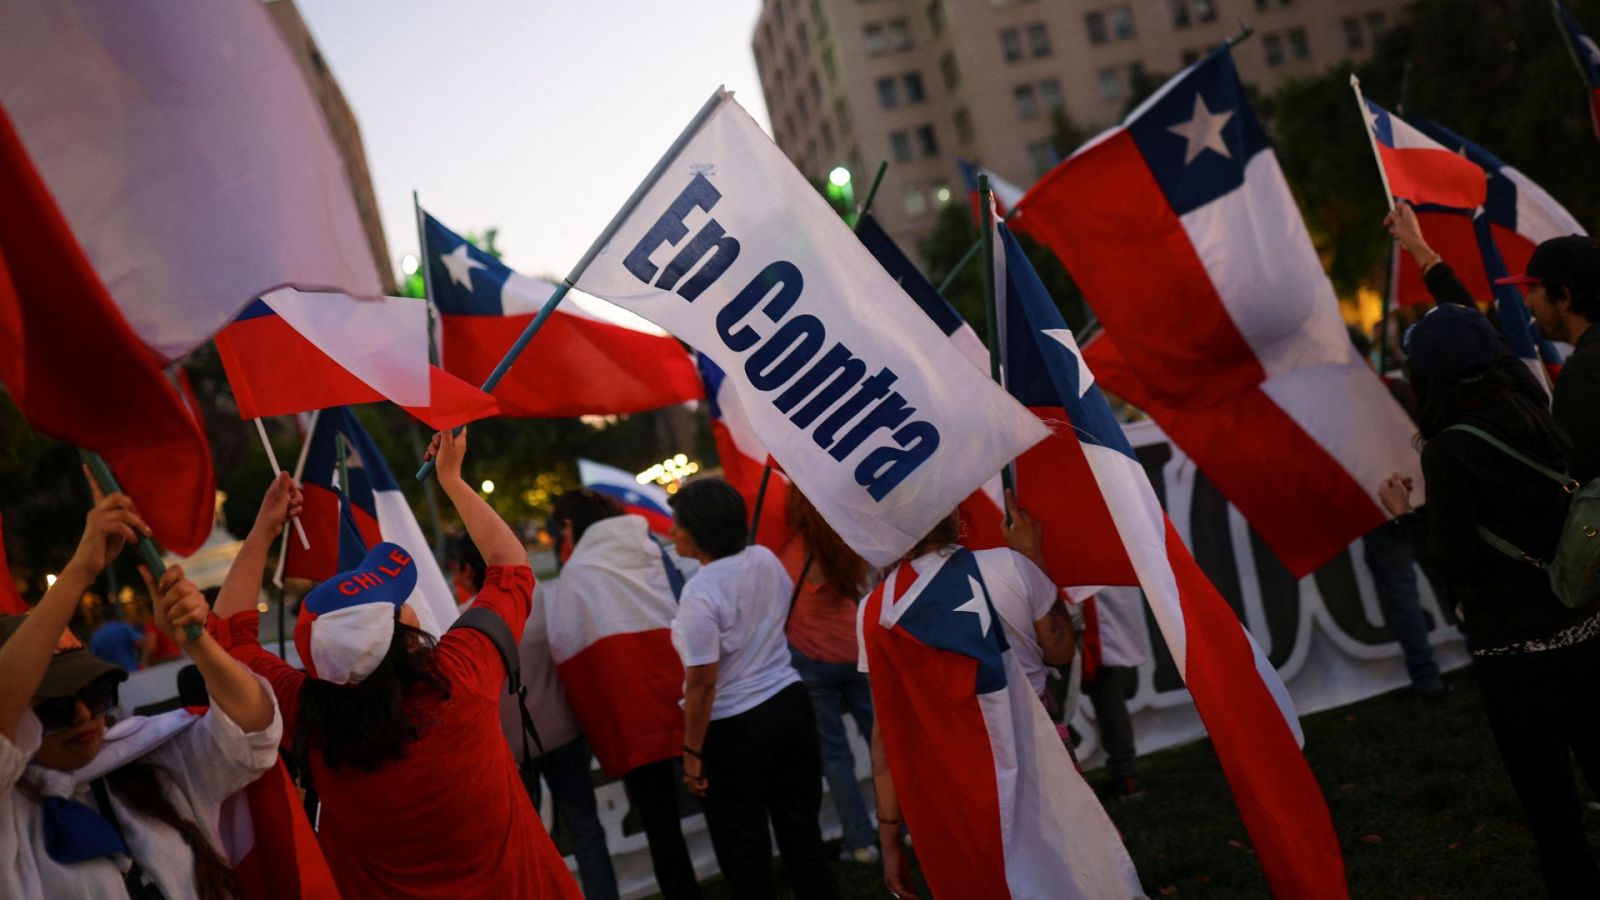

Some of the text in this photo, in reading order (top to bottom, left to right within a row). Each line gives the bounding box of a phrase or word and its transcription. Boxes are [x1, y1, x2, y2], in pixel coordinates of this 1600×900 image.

[623, 172, 940, 502] En Contra
[338, 549, 411, 596] CHILE
